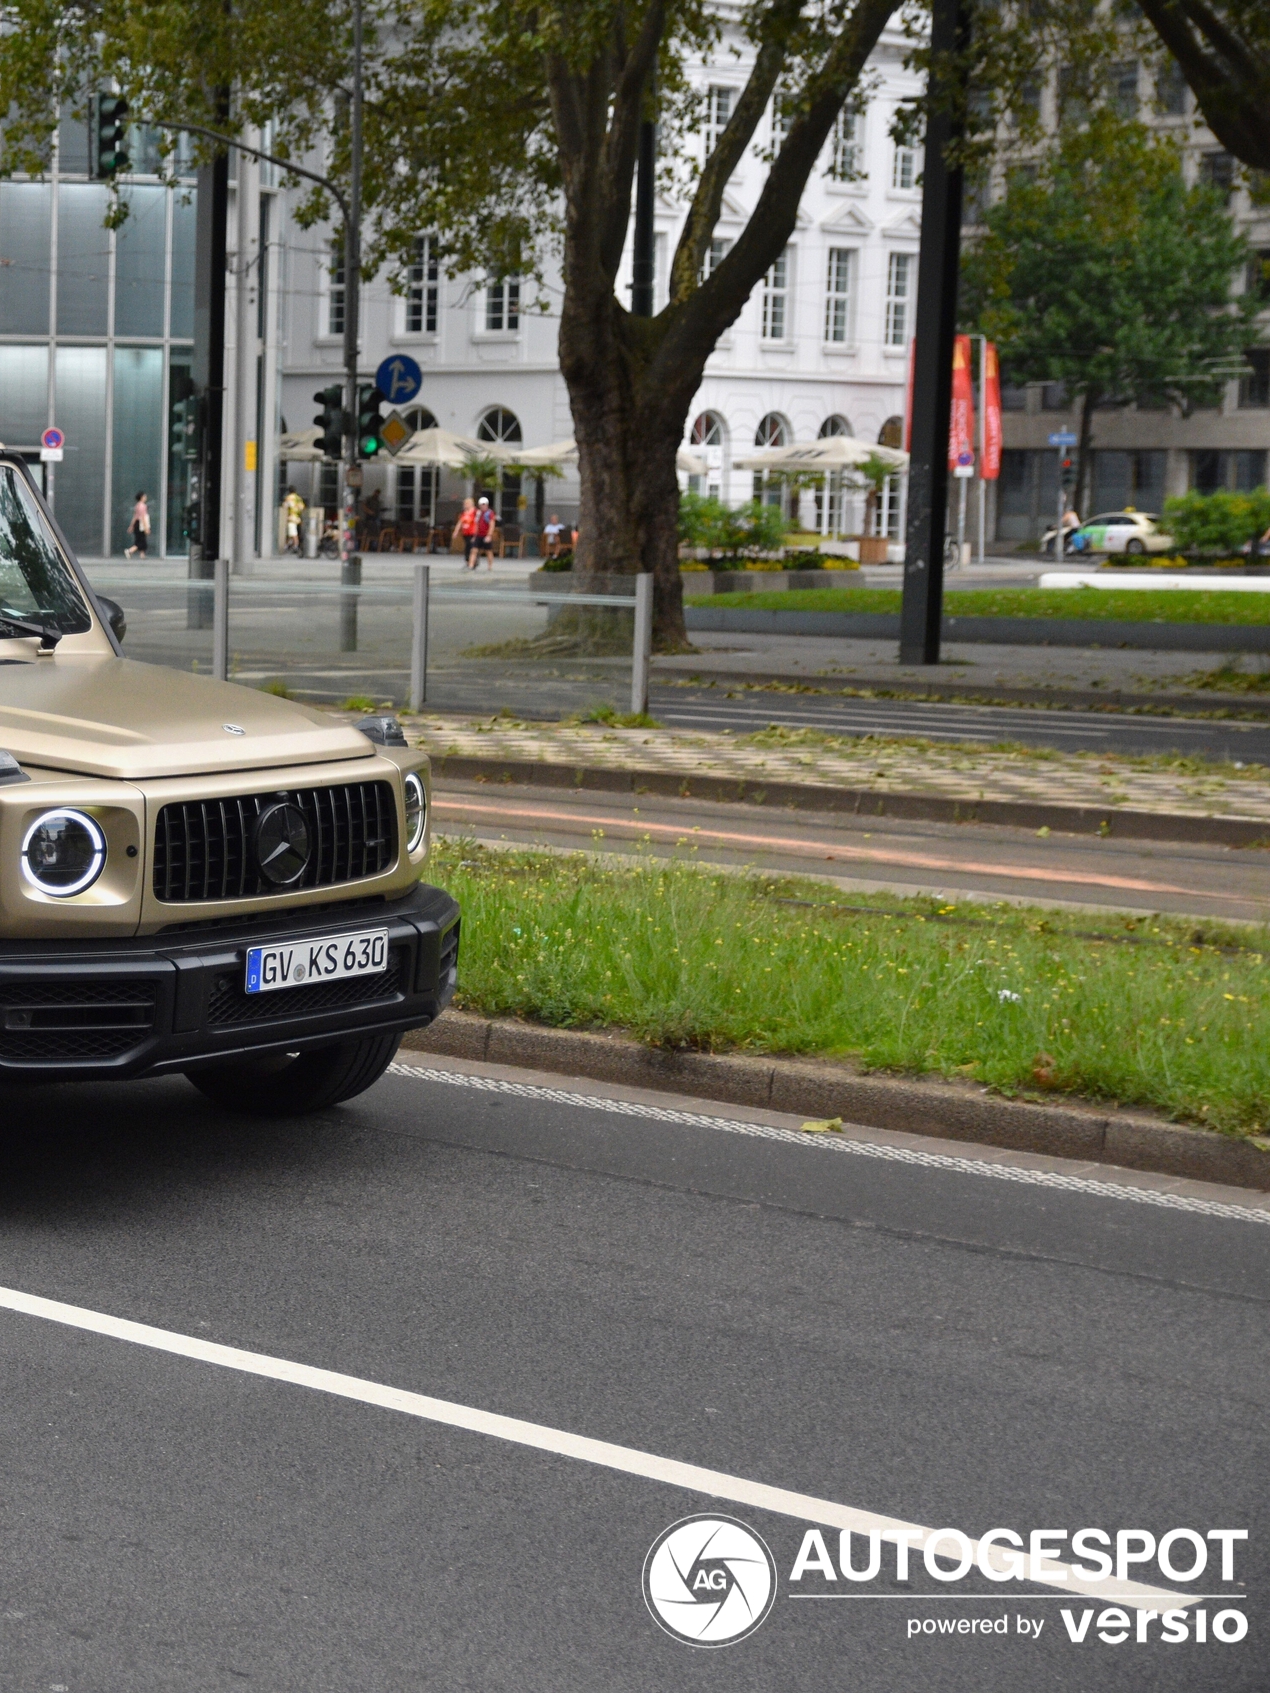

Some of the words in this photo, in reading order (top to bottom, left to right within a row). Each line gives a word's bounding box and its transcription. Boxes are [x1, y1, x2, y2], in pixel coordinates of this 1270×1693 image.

[262, 950, 294, 984] GV
[308, 943, 338, 977] KS
[343, 936, 385, 971] 630
[250, 975, 257, 984] D
